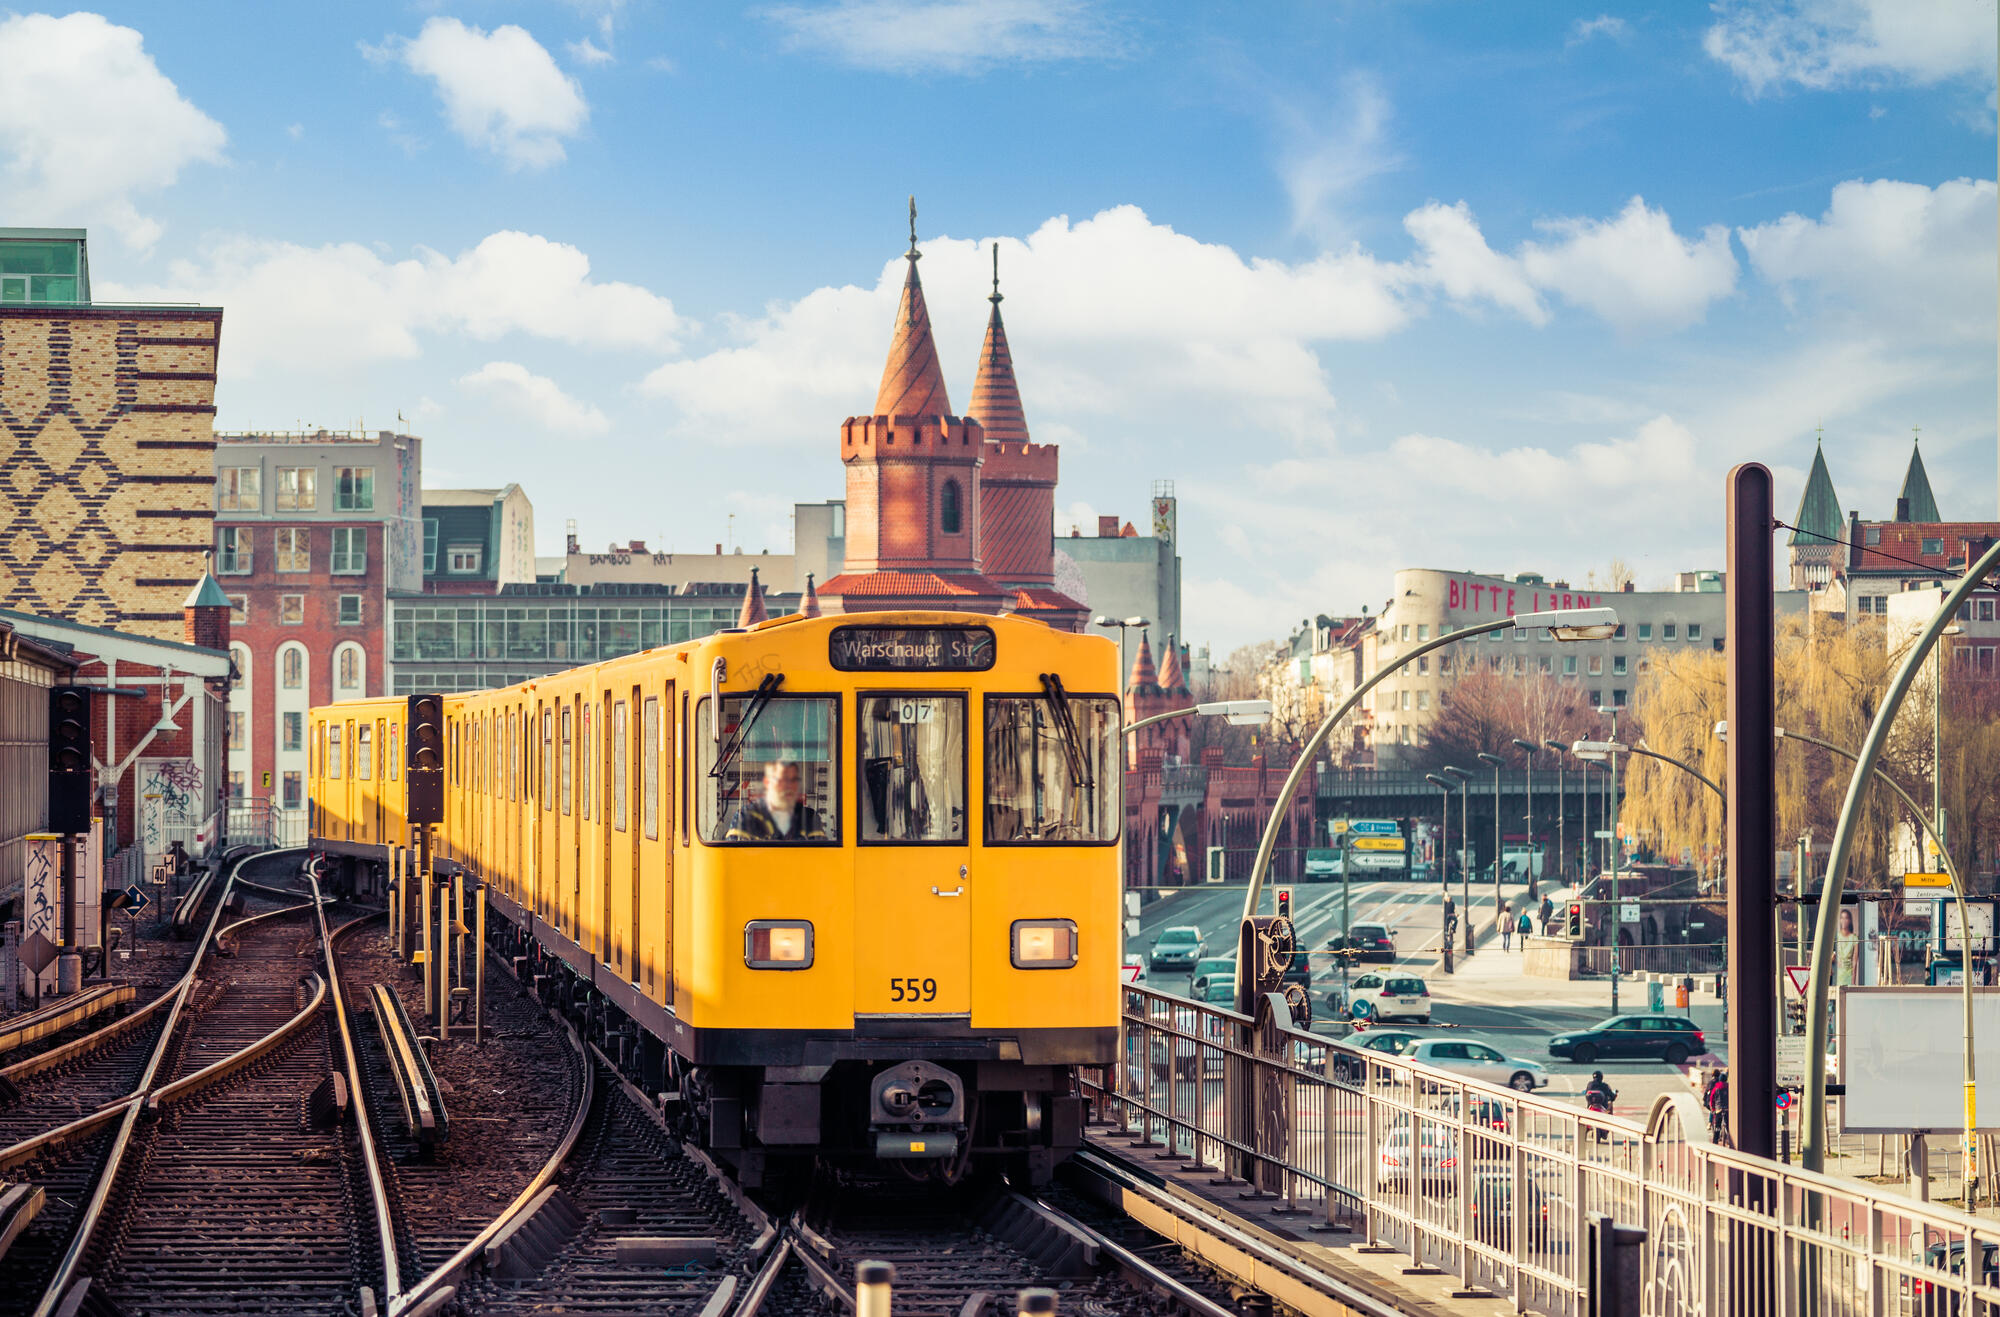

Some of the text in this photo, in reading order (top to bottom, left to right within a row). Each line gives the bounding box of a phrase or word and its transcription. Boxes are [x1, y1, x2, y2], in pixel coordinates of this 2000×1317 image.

[589, 554, 631, 565] BAMBOO
[1449, 578, 1515, 616] BITTE
[845, 641, 978, 658] Warschauer Str.
[902, 704, 931, 720] 07
[263, 772, 270, 786] F
[154, 868, 165, 882] 40
[890, 978, 937, 1002] 559
